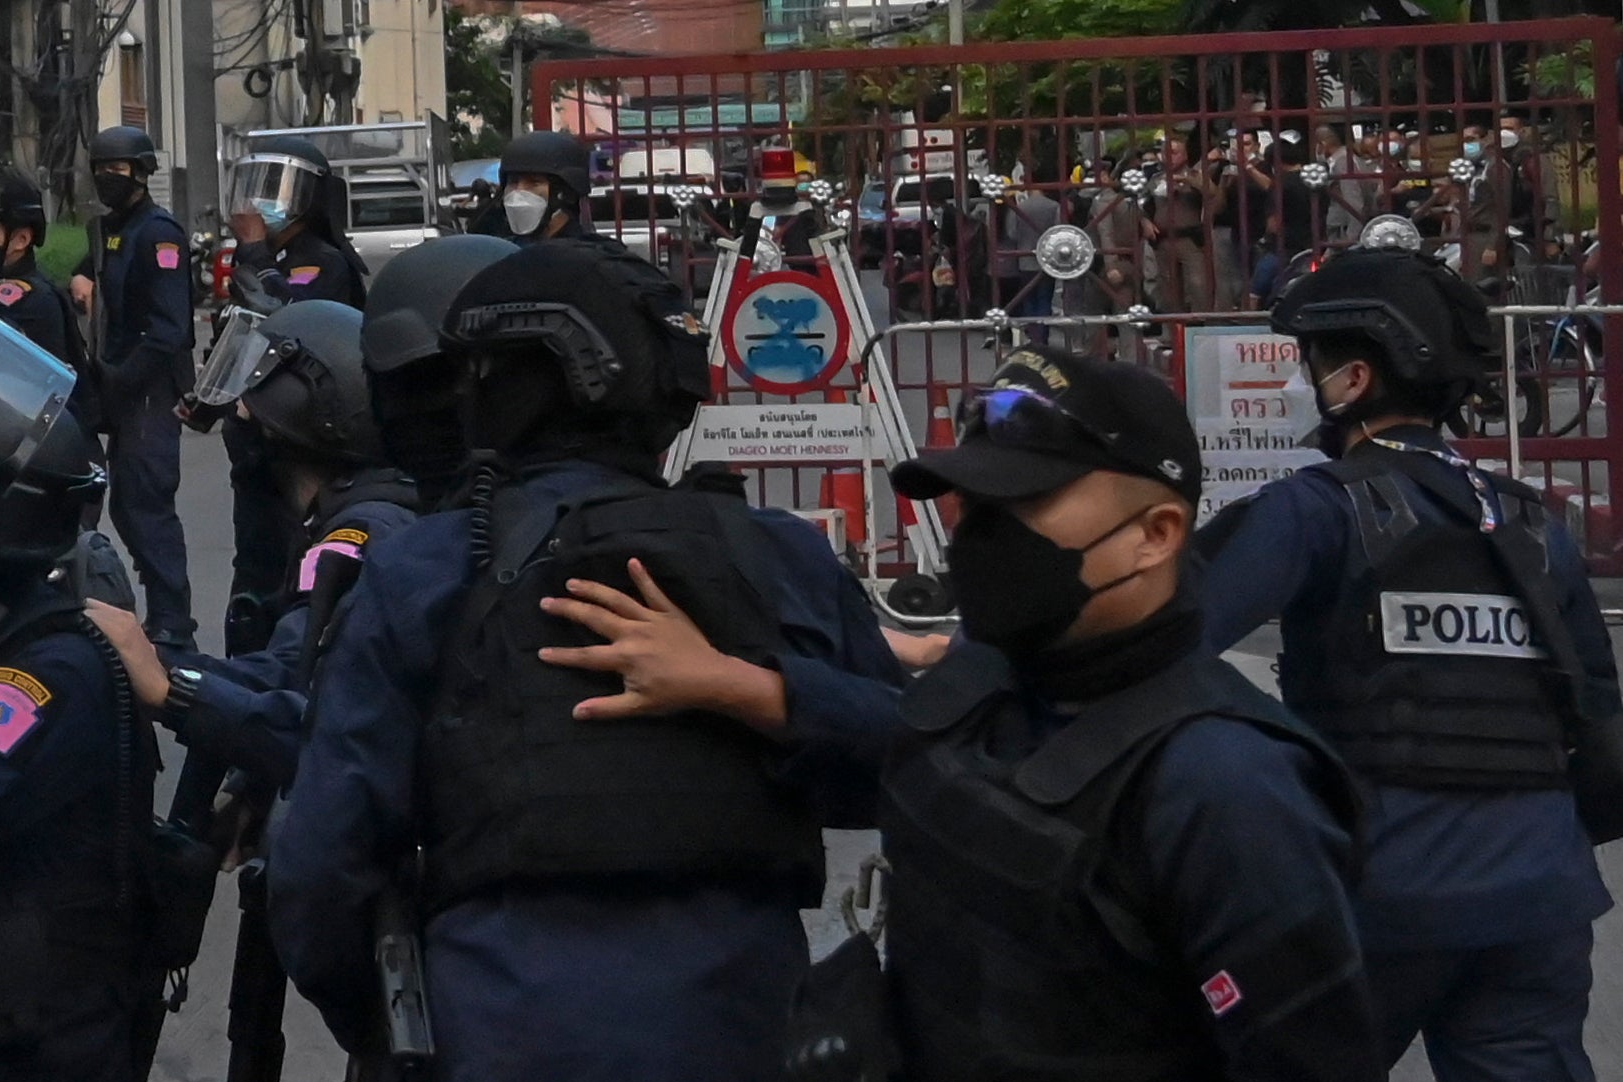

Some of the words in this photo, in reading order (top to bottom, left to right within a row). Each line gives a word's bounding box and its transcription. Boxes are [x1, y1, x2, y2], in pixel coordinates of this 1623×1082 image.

[1235, 341, 1300, 374] หยุด
[1230, 396, 1288, 420] ตรว
[728, 446, 768, 456] DIAGEO
[800, 445, 850, 455] HENNESSY
[1401, 603, 1529, 647] POLIC
